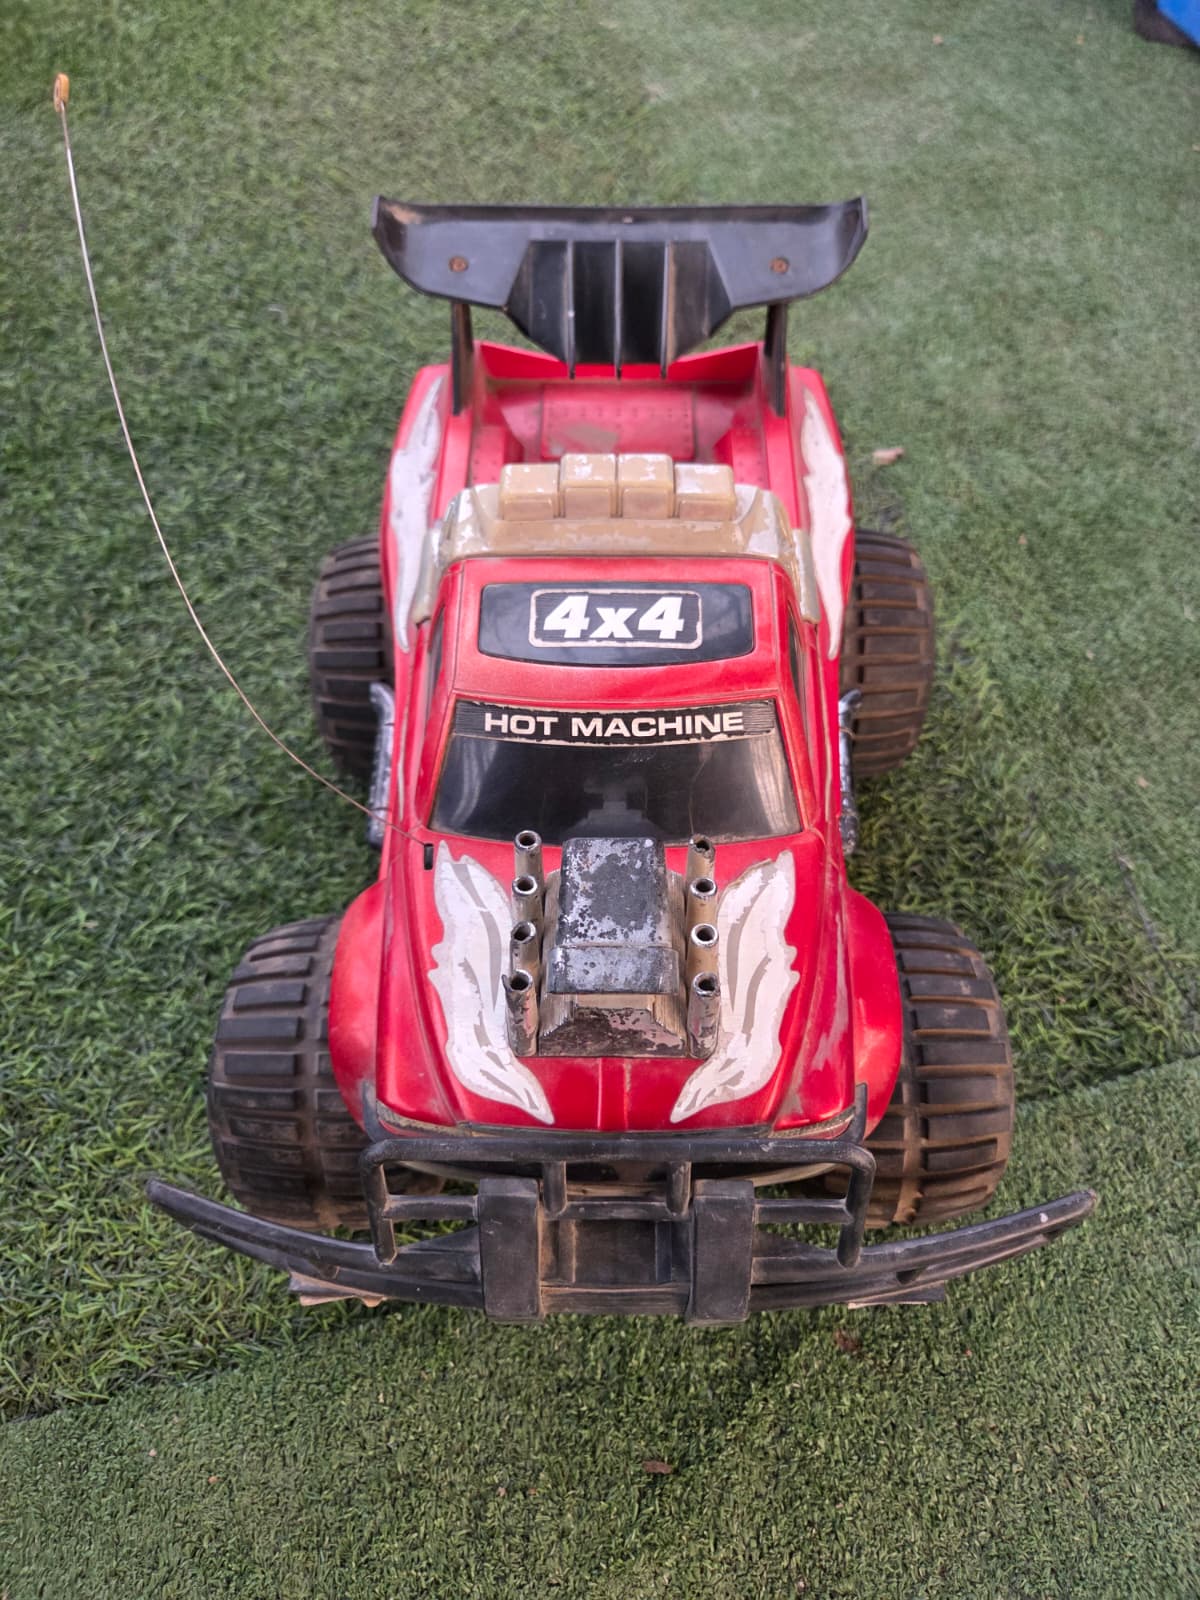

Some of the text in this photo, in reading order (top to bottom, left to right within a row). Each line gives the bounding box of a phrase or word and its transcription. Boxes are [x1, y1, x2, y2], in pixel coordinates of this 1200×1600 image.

[543, 595, 685, 640] 4x4
[484, 711, 745, 737] HOT MACHINE
